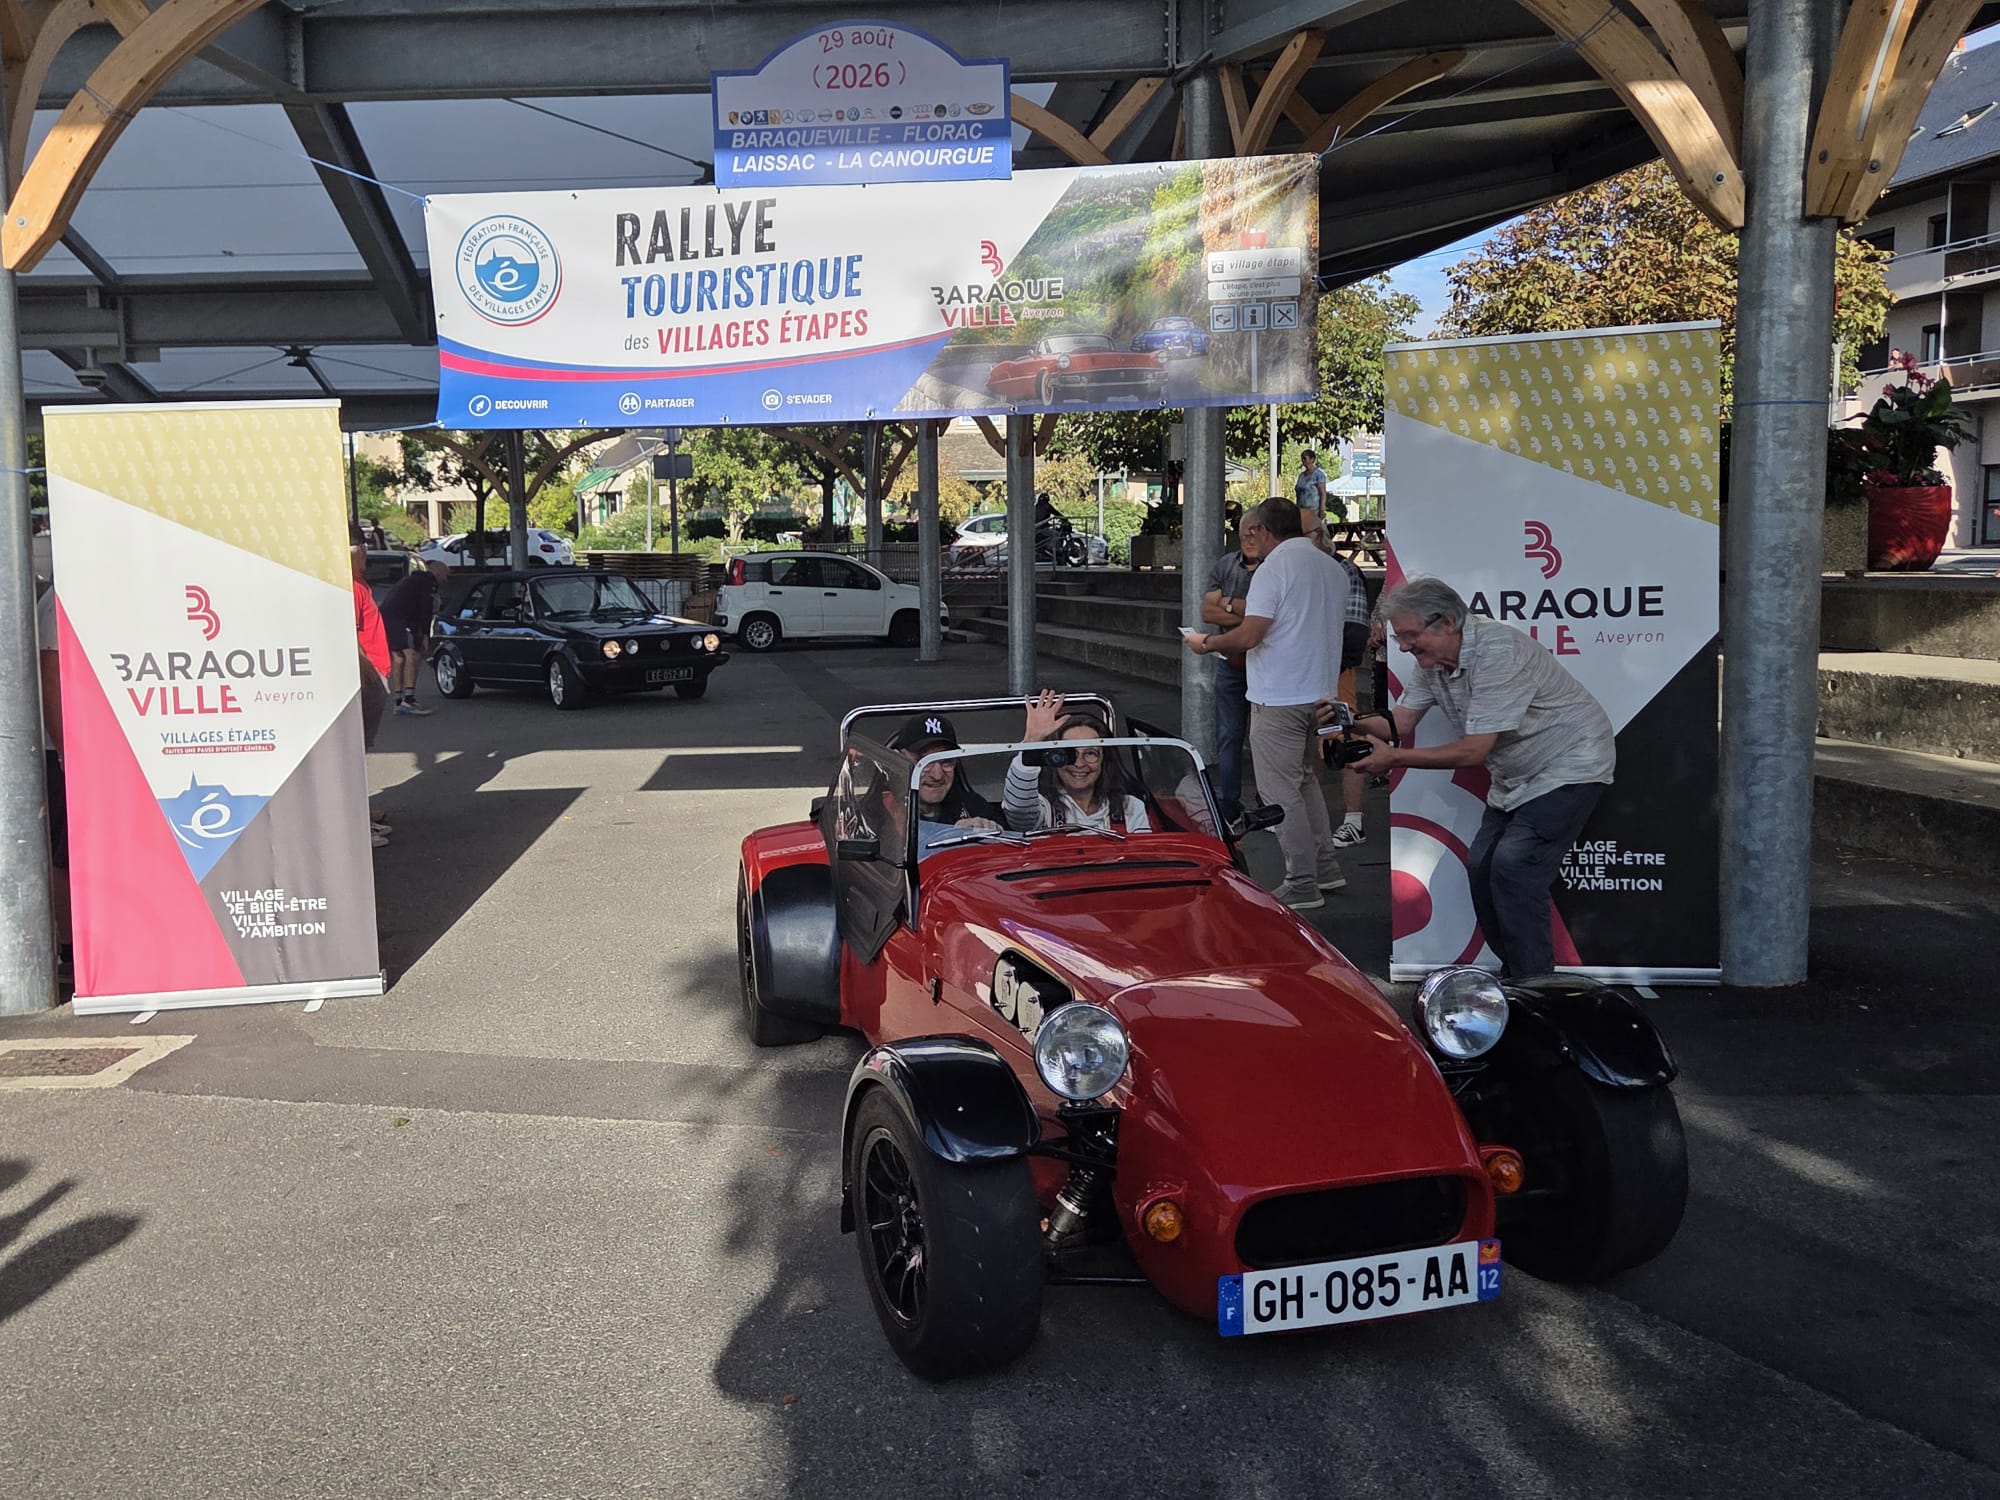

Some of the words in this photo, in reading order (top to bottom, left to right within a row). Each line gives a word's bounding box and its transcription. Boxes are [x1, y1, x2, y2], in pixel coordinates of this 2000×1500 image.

[818, 30, 845, 53] 29
[852, 28, 896, 49] août
[731, 127, 881, 149] BARAQUEVILLE
[902, 122, 983, 142] FLORAC
[732, 153, 816, 173] LAISSAC
[838, 151, 864, 169] LA
[869, 146, 995, 168] CANOURGUE
[463, 222, 505, 263] FÉDÉRATION
[508, 223, 549, 260] FRANÇAISE
[615, 198, 777, 267] RALLYE
[1229, 259, 1264, 270] village
[620, 254, 864, 319] TOURISTIQUE
[931, 279, 1063, 305] BARAQUE
[469, 284, 484, 302] DES
[484, 299, 525, 315] VILLAGES
[525, 283, 549, 310] ÉTAPES
[940, 303, 1016, 328] VILLE
[1023, 307, 1064, 320] Aveyron
[624, 333, 650, 351] des
[657, 318, 770, 355] VILLAGES
[779, 308, 869, 344] ÉTAPES
[495, 399, 549, 410] DECOUVRIR
[644, 397, 695, 409] PARTAGER
[786, 393, 833, 405] S'EVADER
[1469, 585, 1665, 621] ARAQUE
[1594, 631, 1665, 646] Aveyron
[110, 647, 312, 681] BARAQUE
[127, 684, 243, 717] VILLE
[254, 689, 314, 705] Aveyron
[160, 731, 223, 744] VILLAGES
[228, 728, 276, 742] ÉTAPES
[924, 717, 942, 735] NY
[1569, 840, 1617, 852] LAGE
[1578, 851, 1666, 865] BIEN-ÊTRE
[1560, 866, 1606, 878] VILLE
[220, 889, 285, 902] VILLAGE
[1563, 878, 1663, 891] D'AMBITION
[226, 902, 245, 915] DE
[250, 897, 328, 914] BIEN-ÊTRE
[232, 914, 275, 927] VILLE
[237, 922, 326, 938] D'AMBITION
[1226, 1307, 1235, 1320] F
[1252, 1252, 1469, 1324] GH-085-AA
[1480, 1269, 1499, 1290] 12
